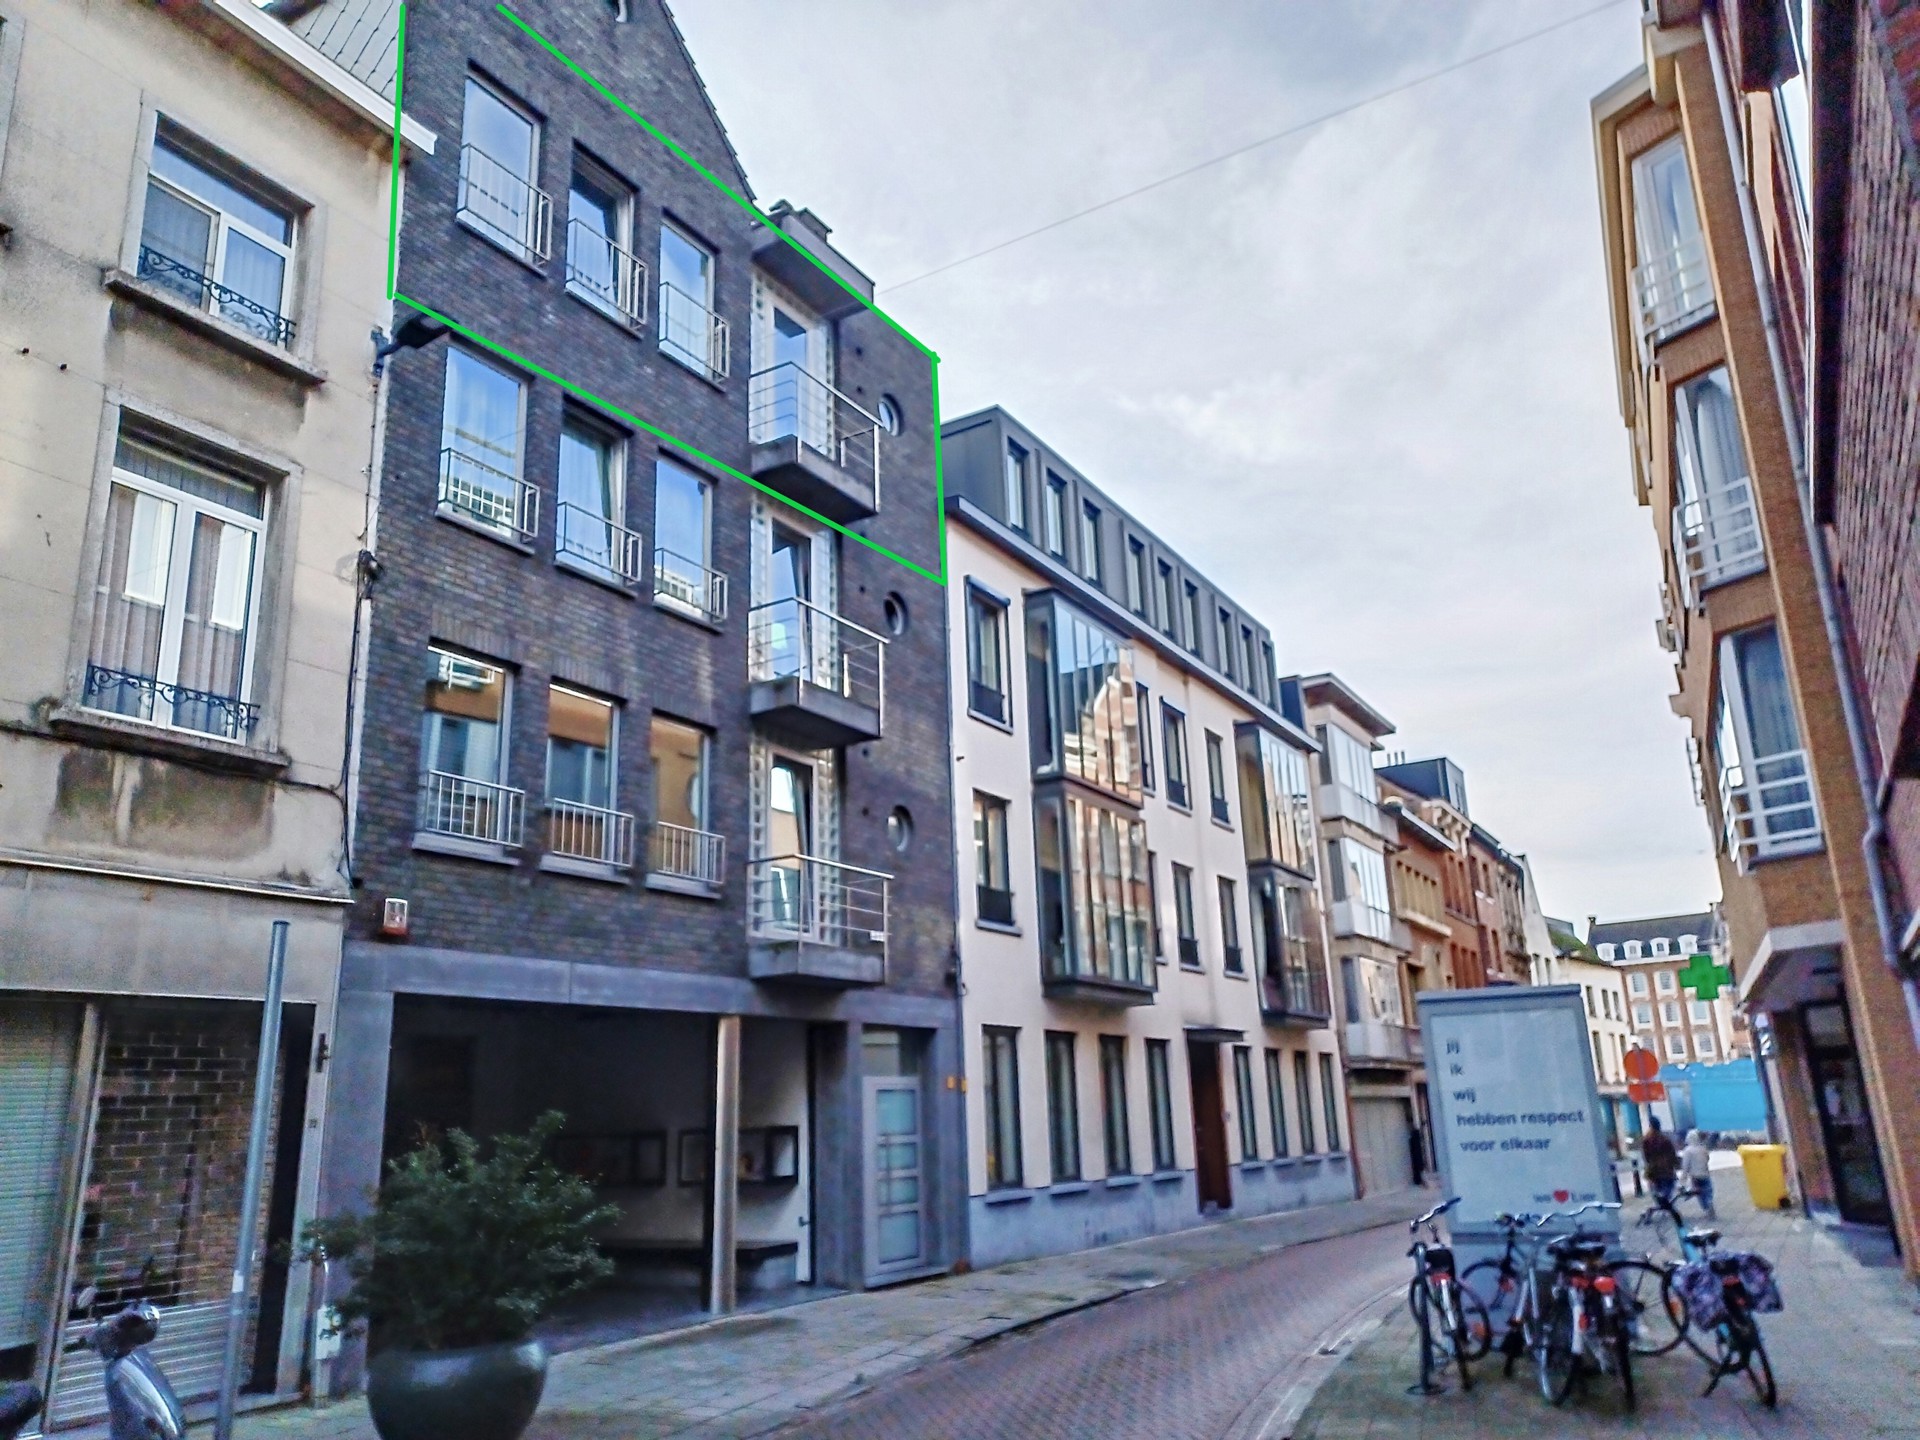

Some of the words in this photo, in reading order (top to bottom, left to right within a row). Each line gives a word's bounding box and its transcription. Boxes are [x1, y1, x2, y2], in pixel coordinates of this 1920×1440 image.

[1447, 1039, 1460, 1054] jij
[1450, 1063, 1464, 1075] ik
[1453, 1087, 1476, 1103] wij
[1456, 1112, 1516, 1126] hebben
[1520, 1110, 1585, 1127] respect
[1460, 1140, 1495, 1151] voor
[1501, 1137, 1550, 1151] elkaar
